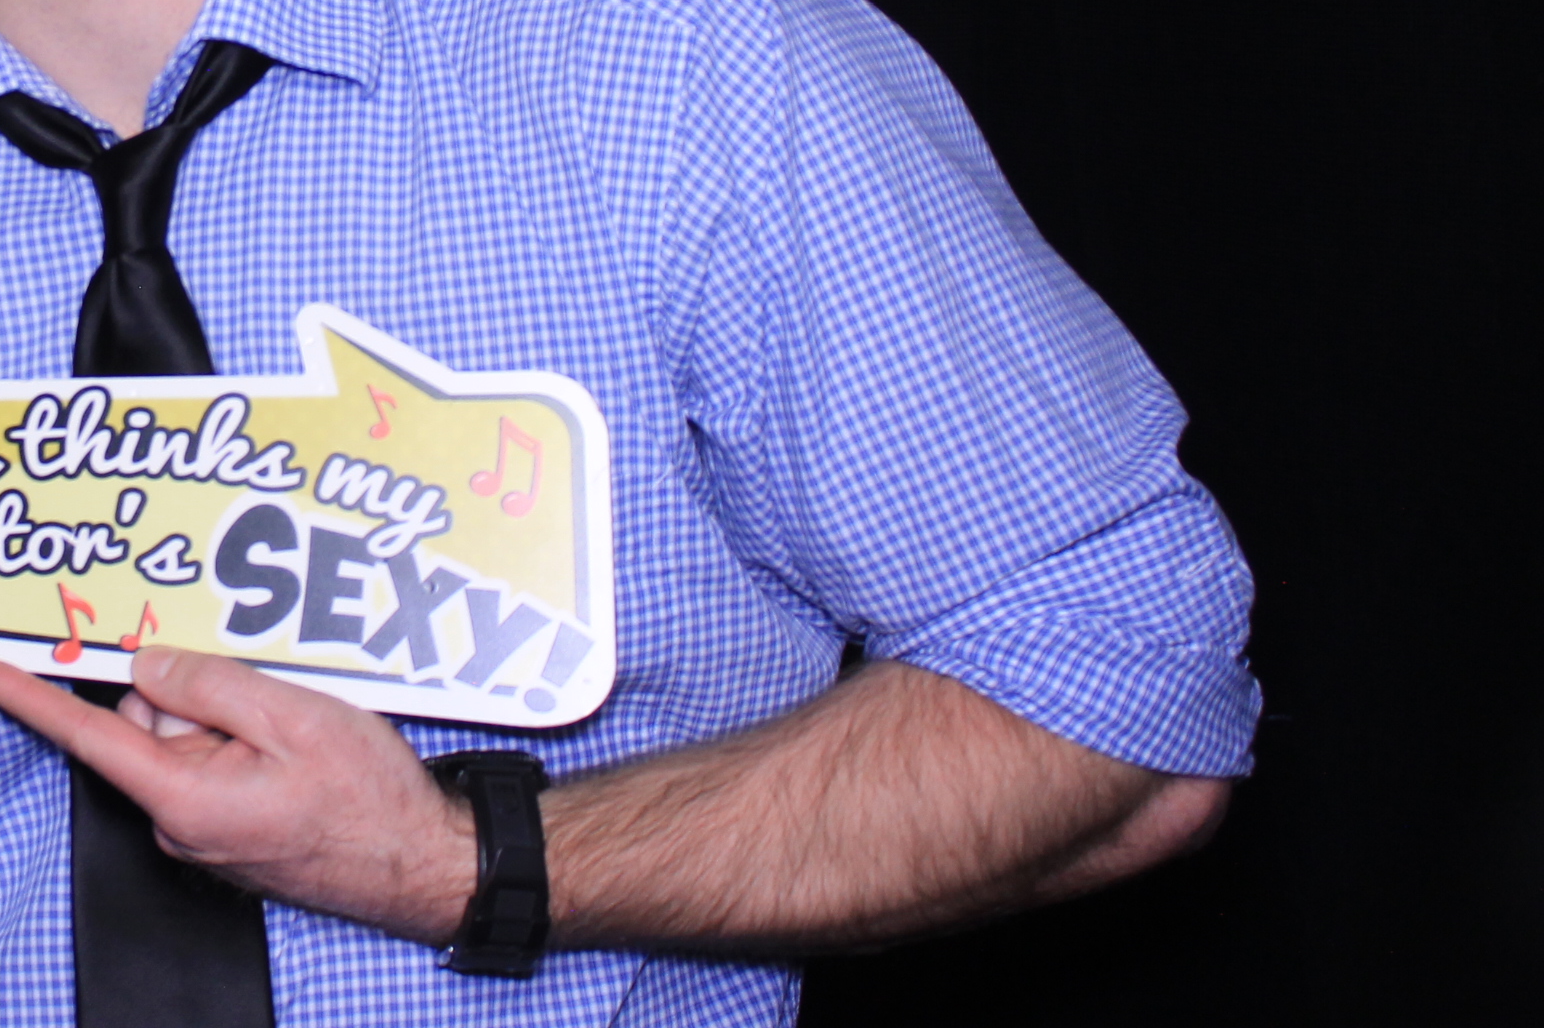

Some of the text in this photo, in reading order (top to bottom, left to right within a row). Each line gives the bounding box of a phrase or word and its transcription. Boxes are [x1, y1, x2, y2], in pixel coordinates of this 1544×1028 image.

[7, 387, 306, 490] thinks
[315, 454, 450, 558] my
[214, 503, 593, 713] SEXY!
